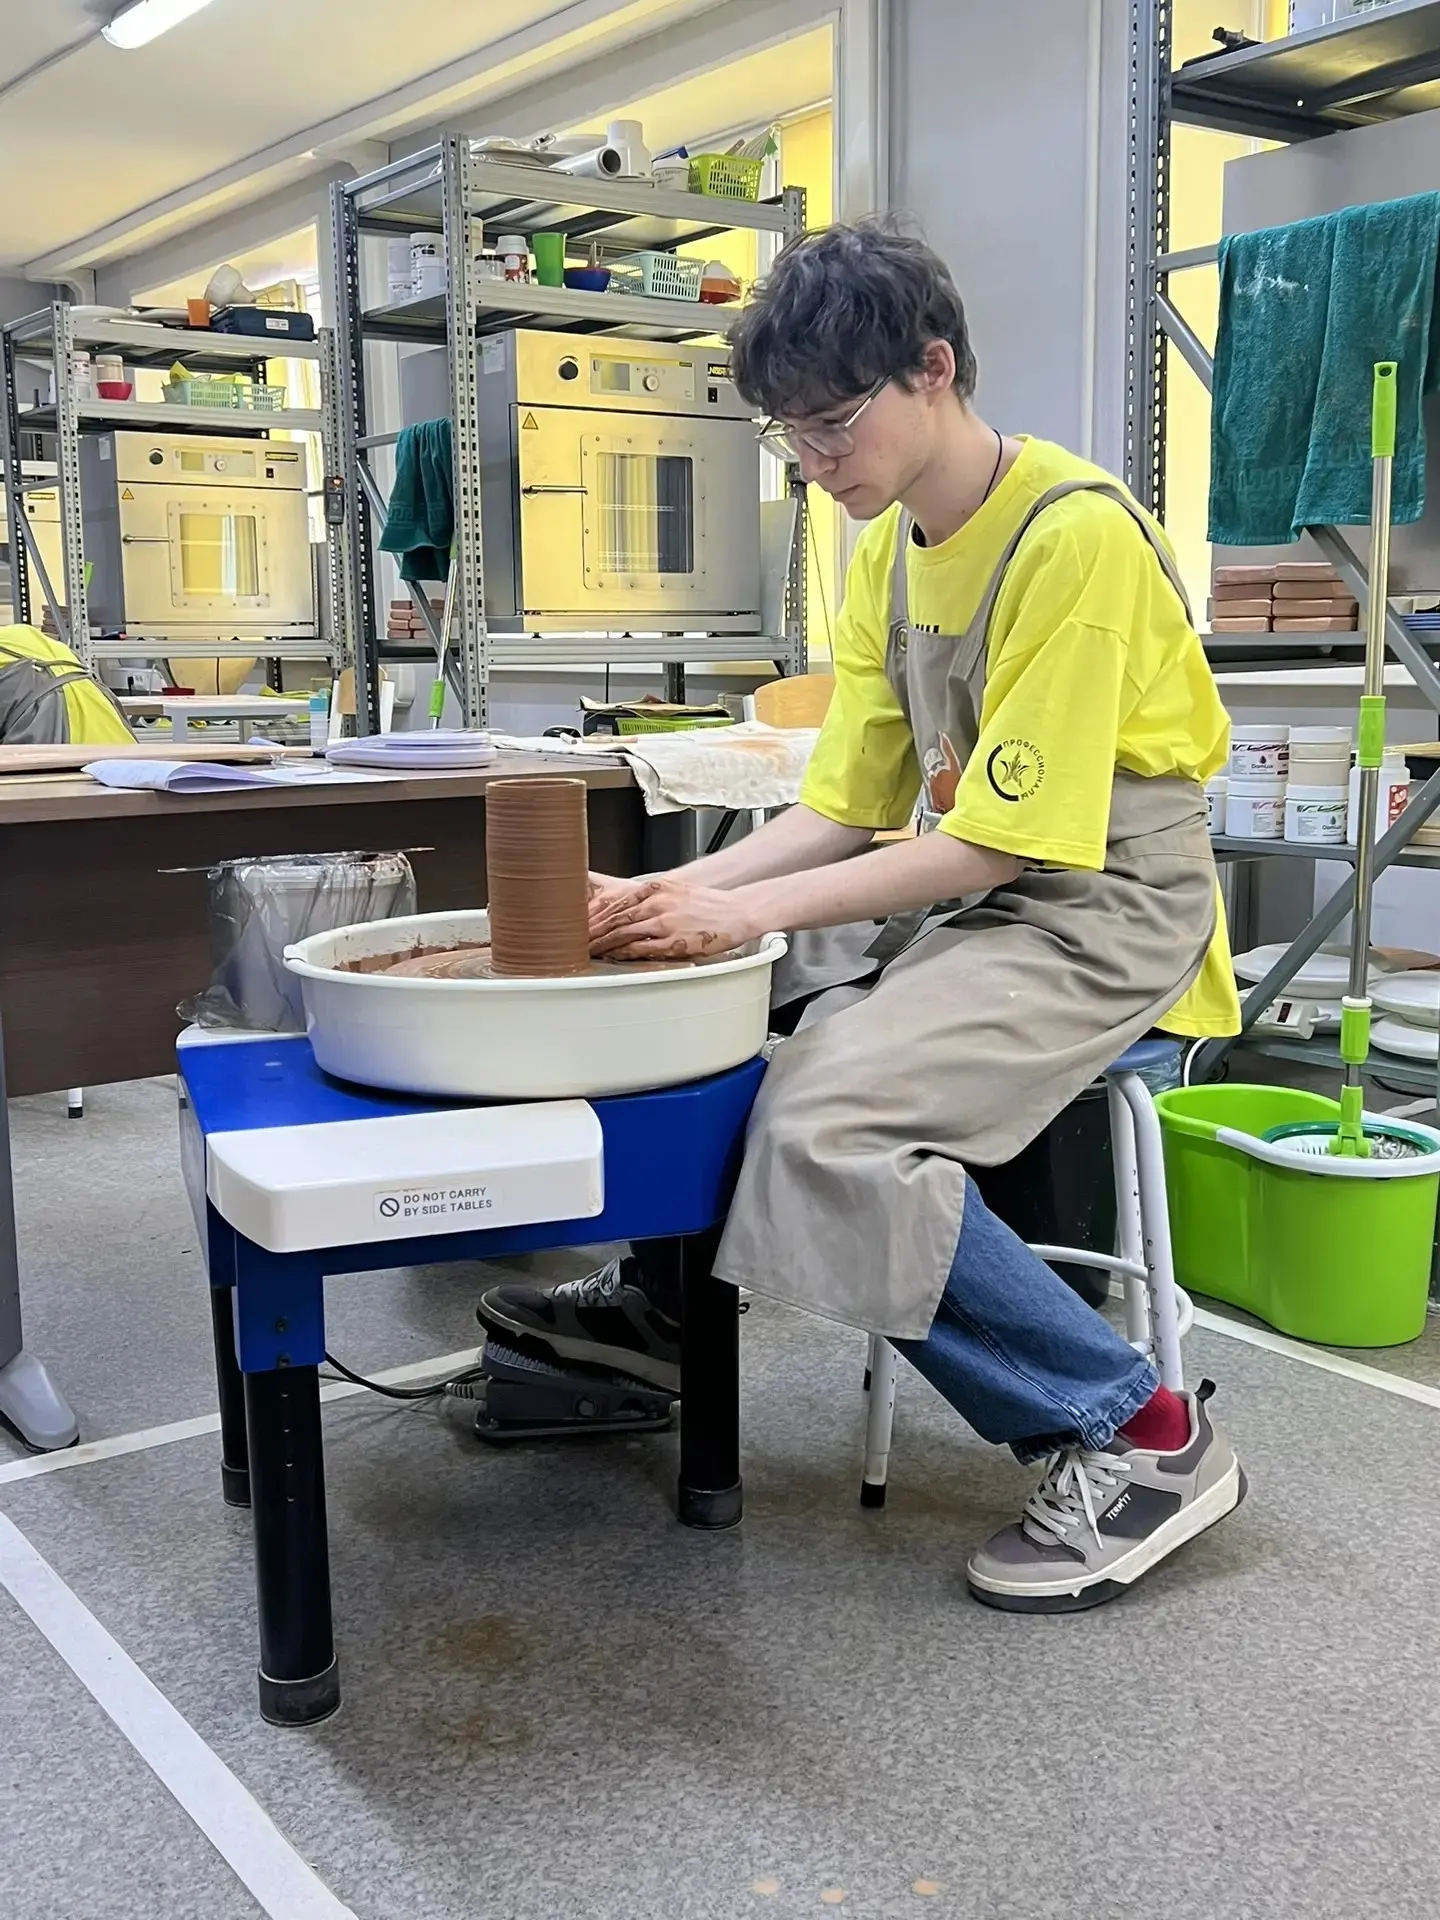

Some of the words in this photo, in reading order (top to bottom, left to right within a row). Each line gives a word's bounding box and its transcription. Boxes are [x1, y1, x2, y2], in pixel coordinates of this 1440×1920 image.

[1002, 738, 1046, 800] ПРОФЕССИОНАЛЫ
[404, 1194, 420, 1204] DO
[423, 1191, 446, 1202] NOT
[449, 1187, 487, 1200] CARRY
[404, 1207, 419, 1217] BY
[422, 1204, 447, 1215] SIDE
[450, 1199, 493, 1212] TABLES
